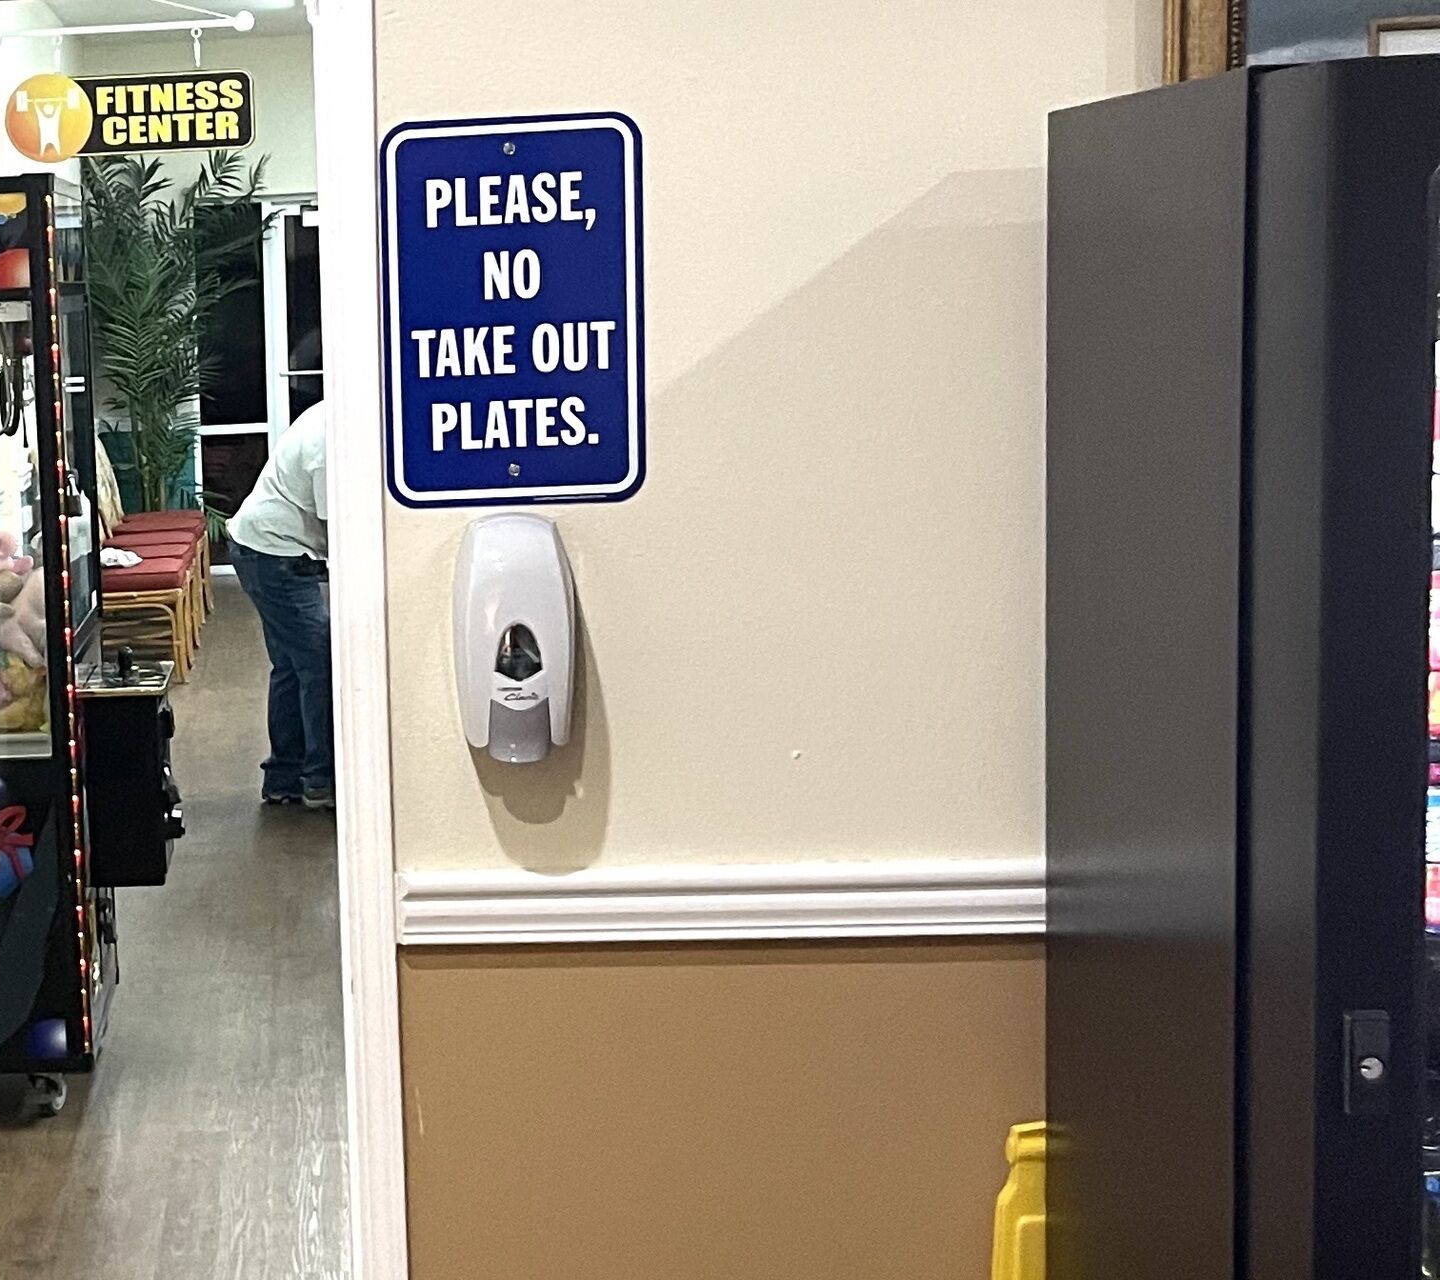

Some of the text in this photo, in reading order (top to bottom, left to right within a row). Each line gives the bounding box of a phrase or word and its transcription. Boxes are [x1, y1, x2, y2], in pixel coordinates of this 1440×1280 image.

[96, 79, 243, 115] FITNESS
[103, 110, 239, 145] CENTER
[425, 170, 597, 230] PLEASE,
[483, 248, 541, 301] NO
[411, 320, 616, 379] TAKE OUT
[431, 396, 599, 452] PLATES.
